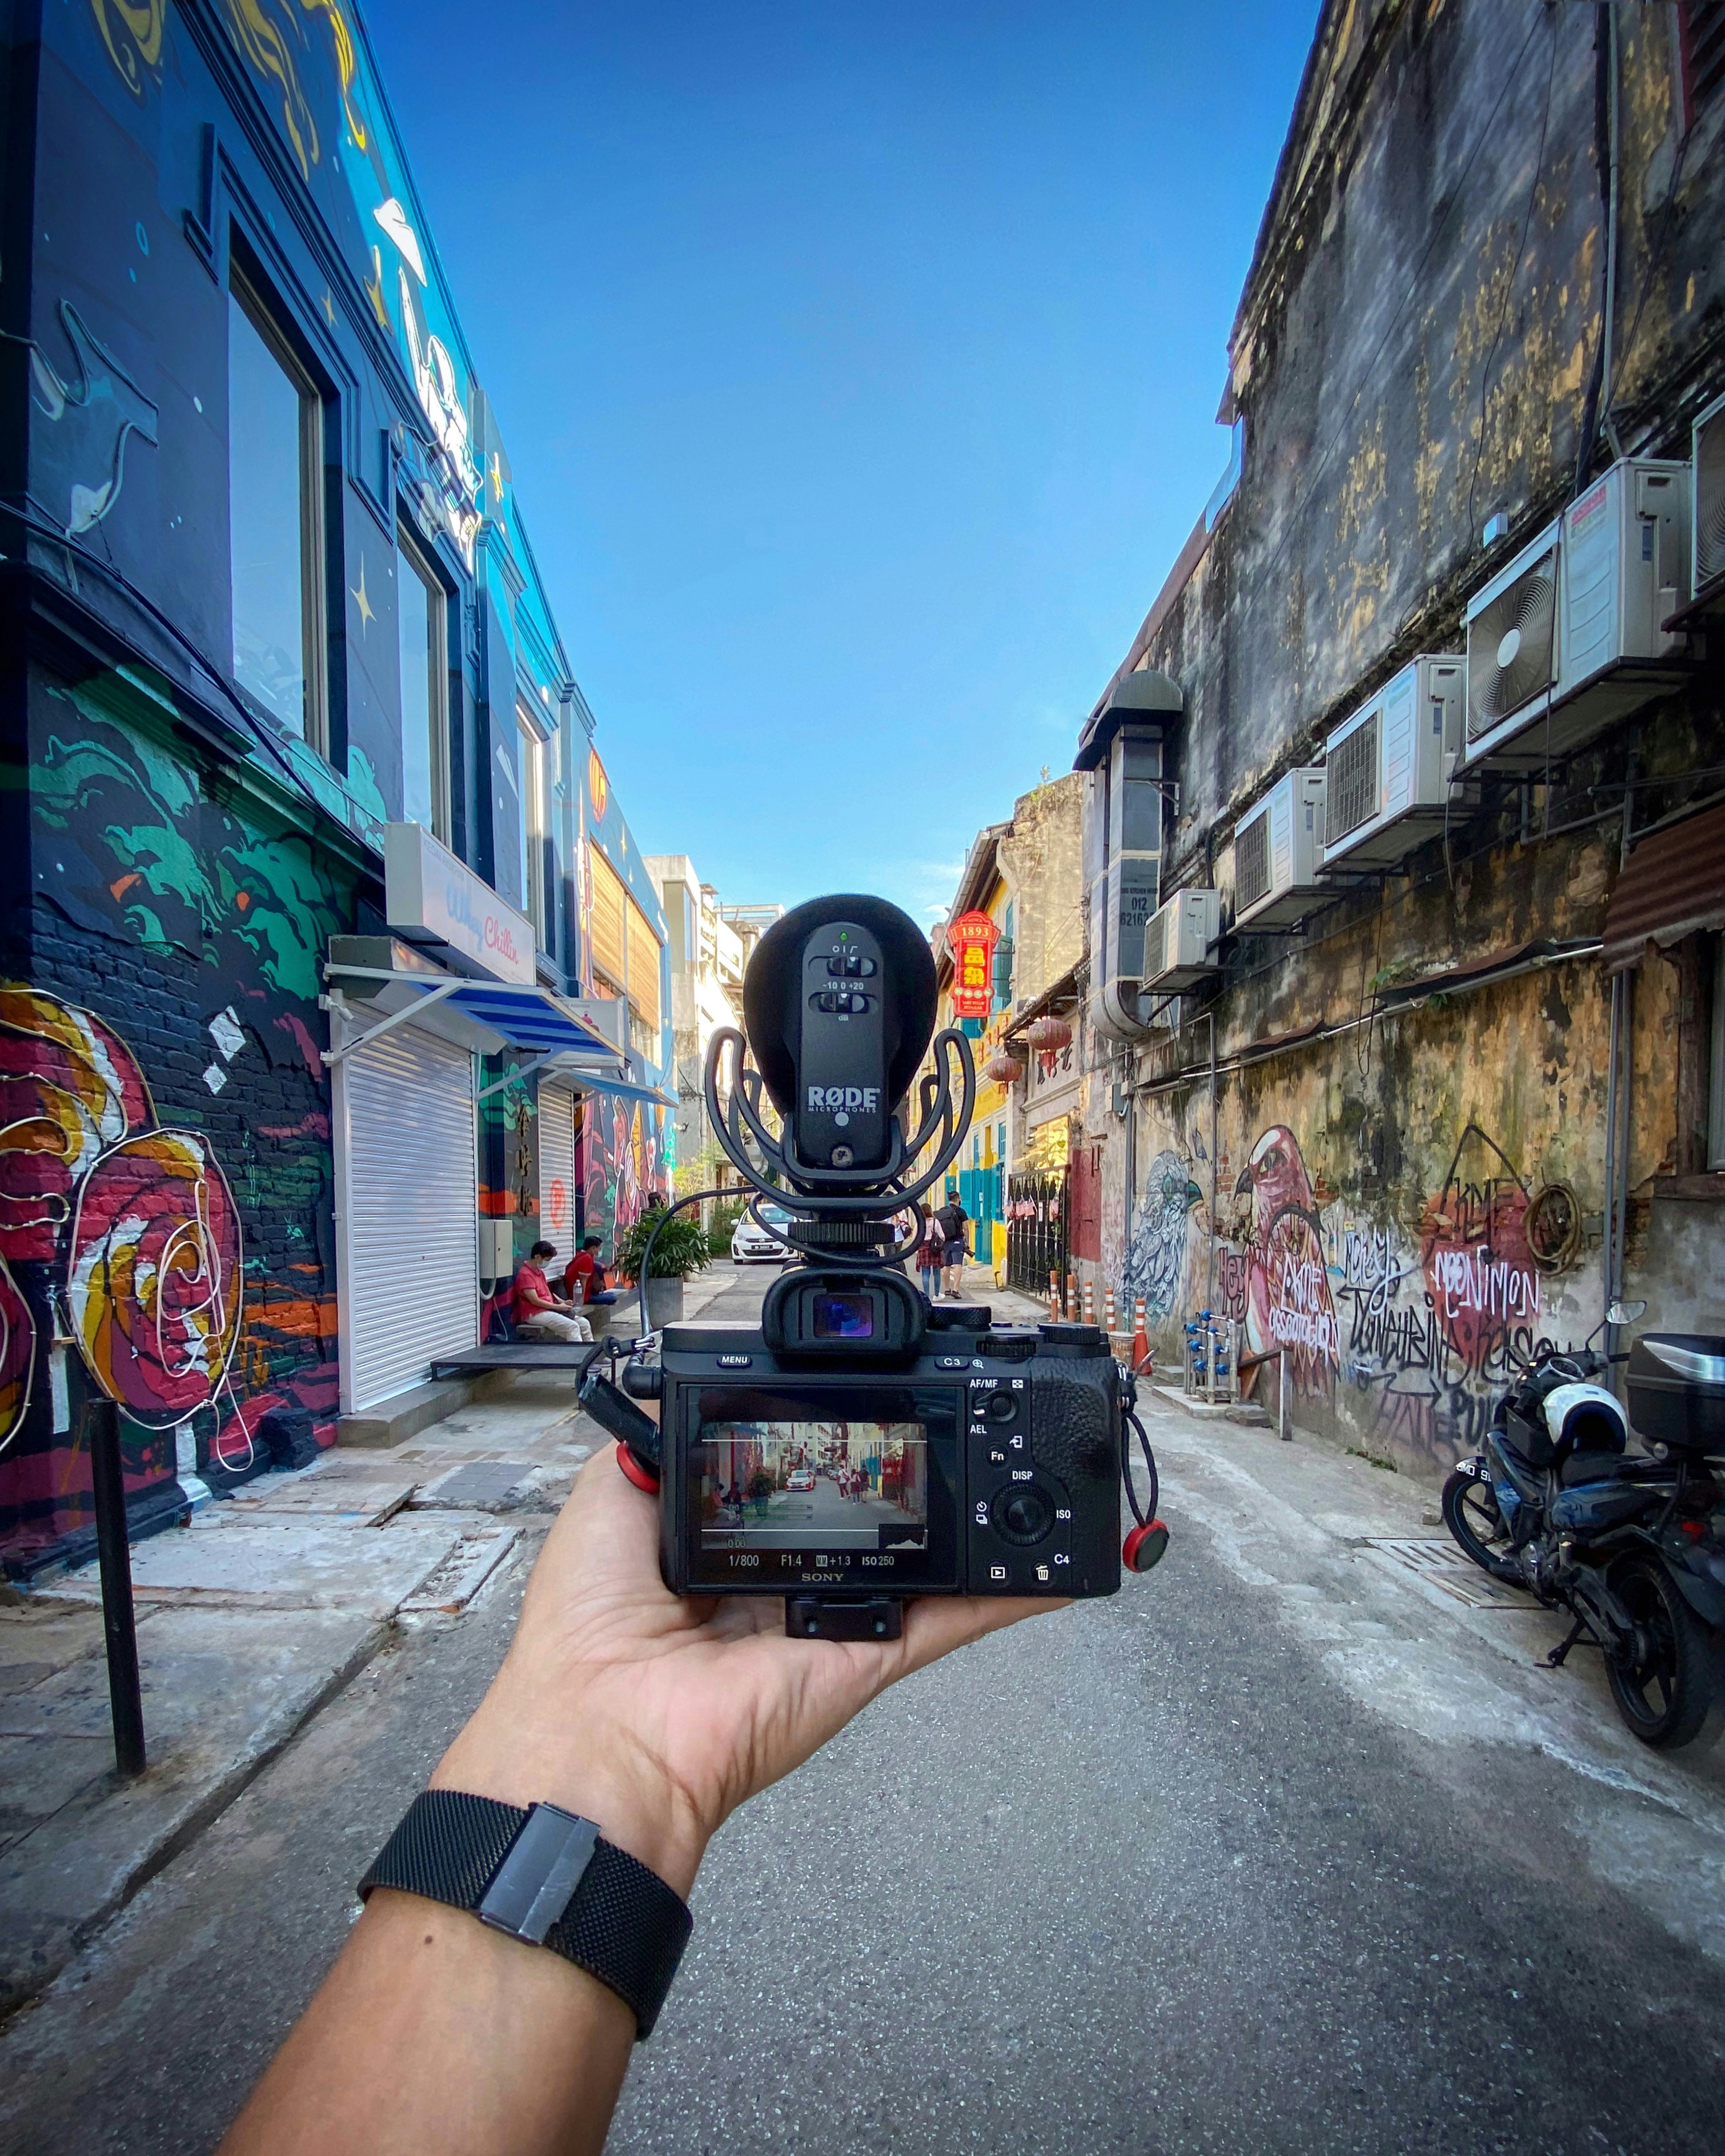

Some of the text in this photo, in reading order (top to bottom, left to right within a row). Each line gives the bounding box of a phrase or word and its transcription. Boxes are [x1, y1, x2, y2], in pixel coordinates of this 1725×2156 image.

[1132, 897, 1147, 911] 012
[961, 926, 989, 937] 1893
[849, 982, 864, 990] +20
[721, 1356, 748, 1364] MENU
[944, 1358, 961, 1366] C3
[970, 1379, 998, 1388] AF/MF
[970, 1424, 988, 1434] AEL
[991, 1451, 1005, 1461] Fn
[1012, 1471, 1033, 1480] DISP
[1056, 1509, 1071, 1519] ISO
[729, 1555, 894, 1567] 1/800 F1.4 +1.3 ISO 250
[1054, 1553, 1070, 1564] C4
[801, 1573, 844, 1581] SONY
